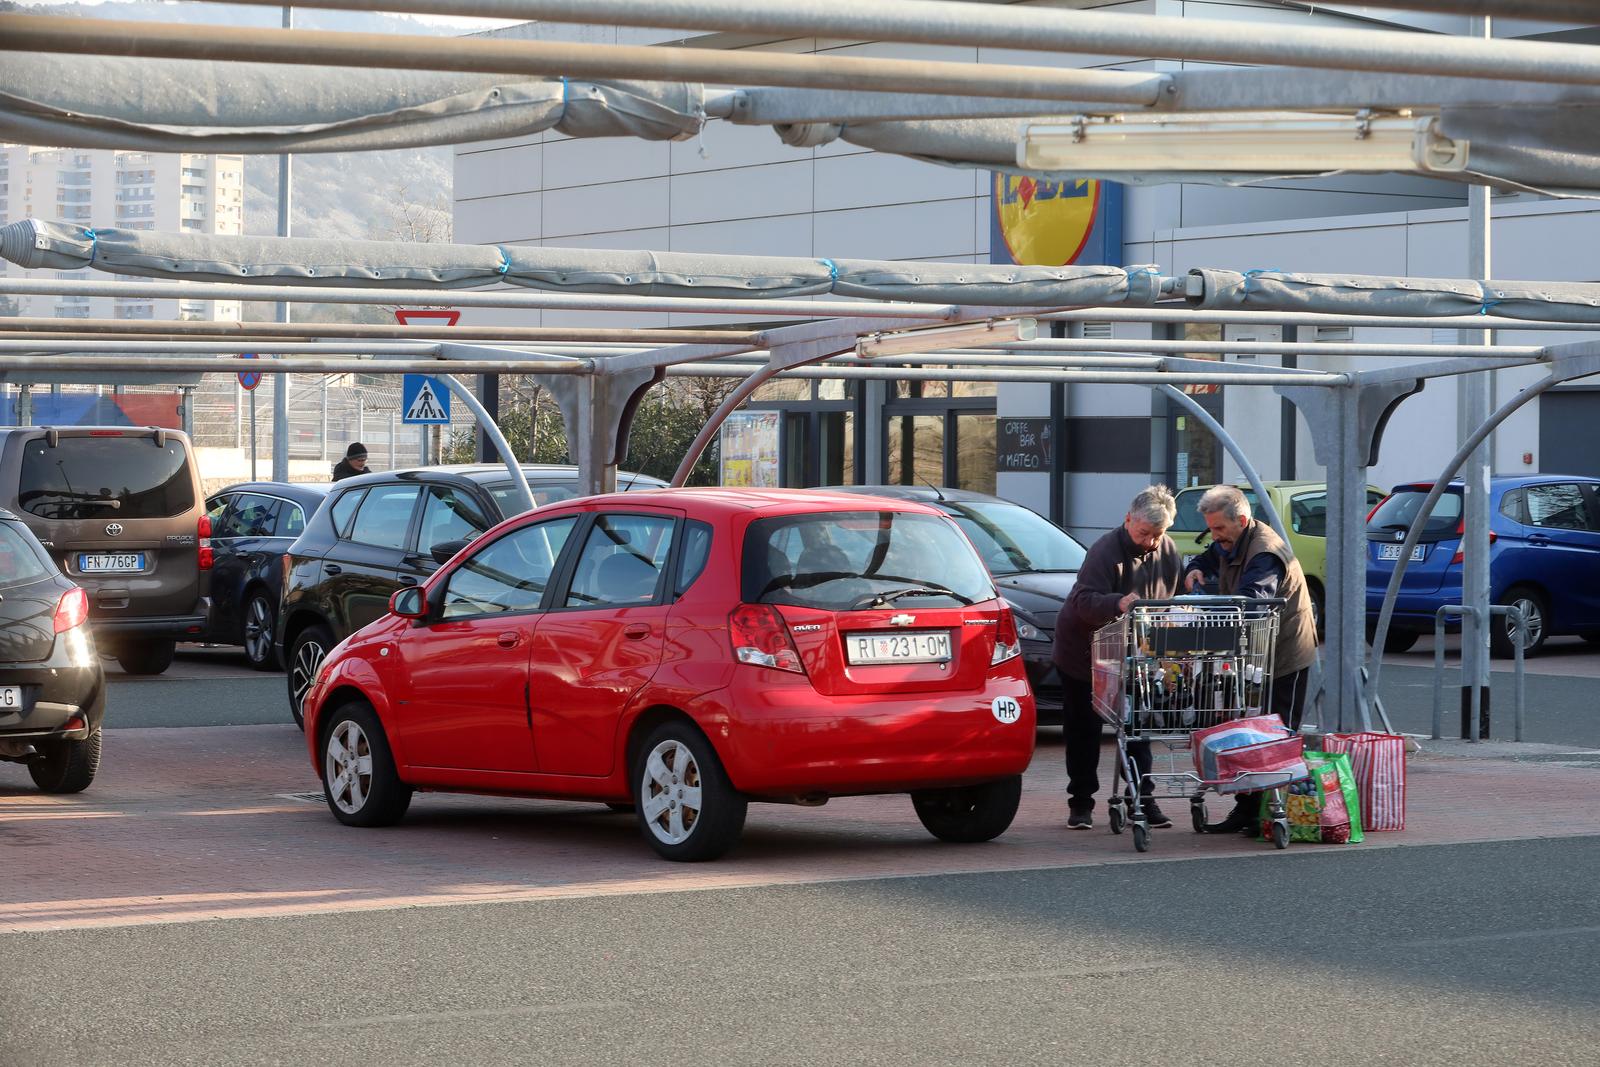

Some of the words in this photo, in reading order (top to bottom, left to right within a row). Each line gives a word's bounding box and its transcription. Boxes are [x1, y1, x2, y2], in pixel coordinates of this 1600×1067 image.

[1005, 421, 1028, 434] CAFFE
[1020, 434, 1035, 447] BAR
[1006, 453, 1039, 468] MATEO
[859, 639, 876, 658] RI
[997, 701, 1016, 718] HR
